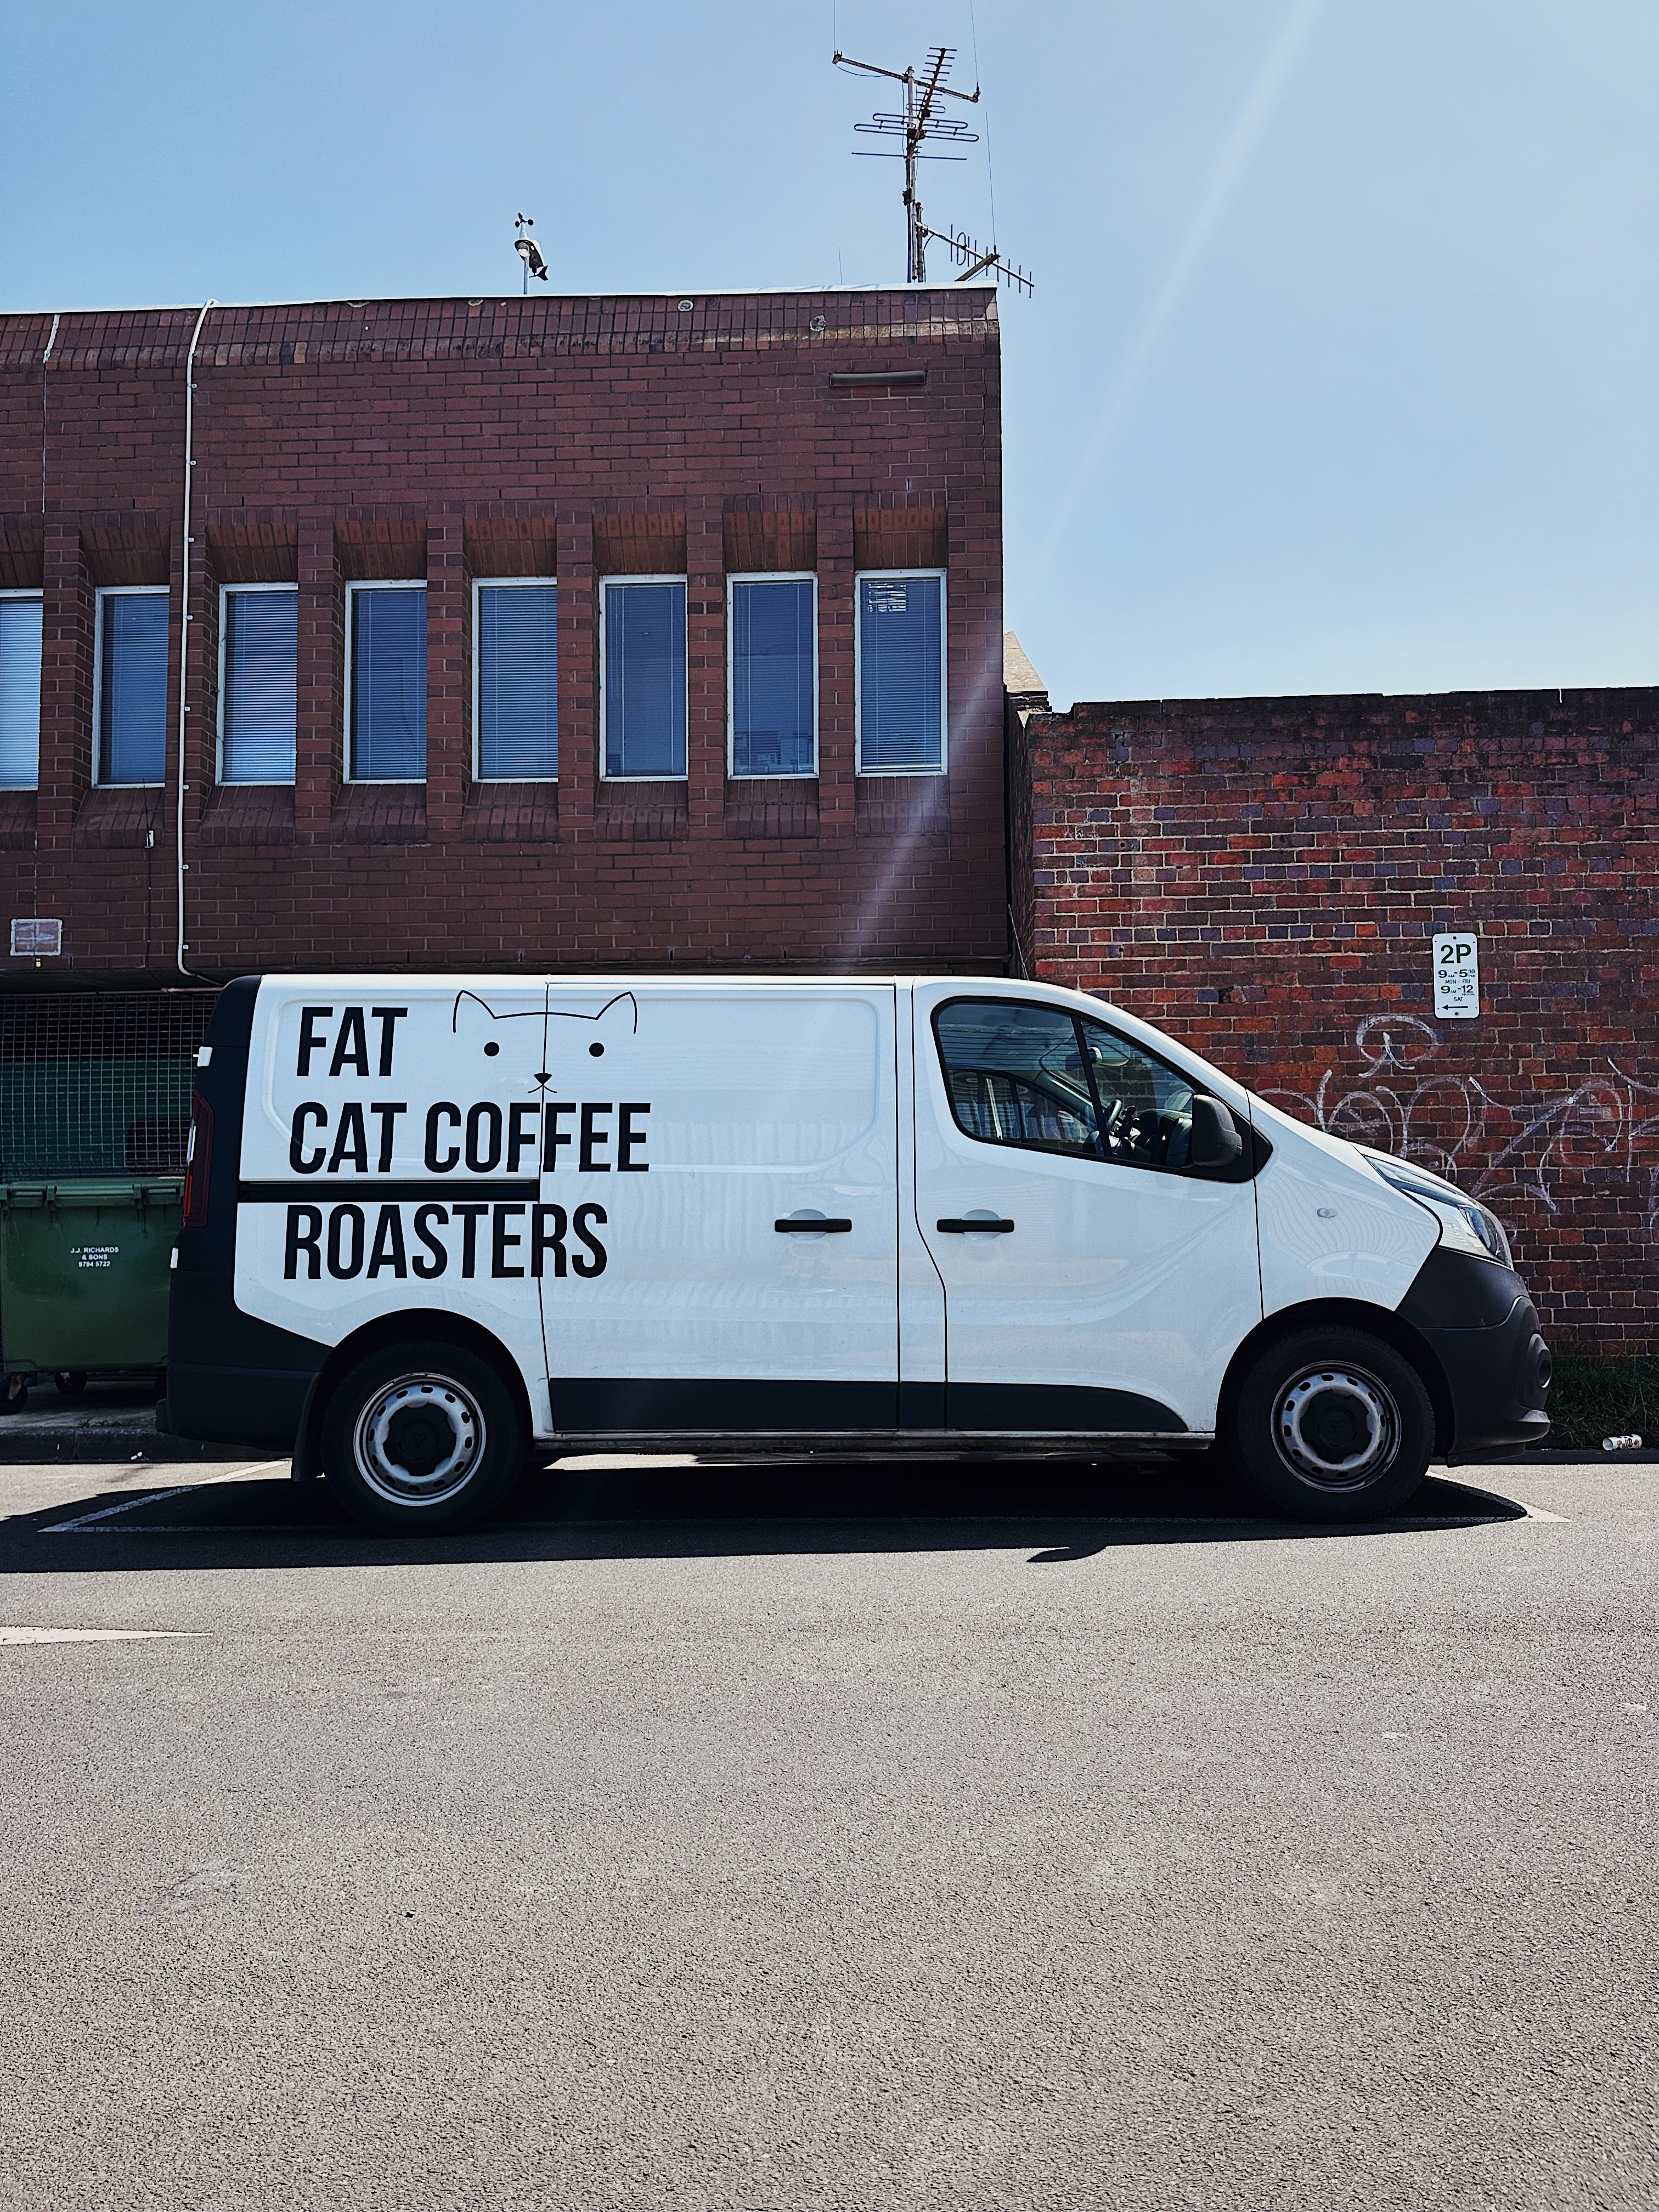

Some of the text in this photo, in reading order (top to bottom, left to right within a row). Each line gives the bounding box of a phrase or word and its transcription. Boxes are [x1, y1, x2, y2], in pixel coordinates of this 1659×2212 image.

[1440, 944, 1471, 964] 2P
[296, 1007, 408, 1077] FAT
[289, 1101, 651, 1174] CAT COFFEE
[284, 1203, 608, 1280] ROASTERS
